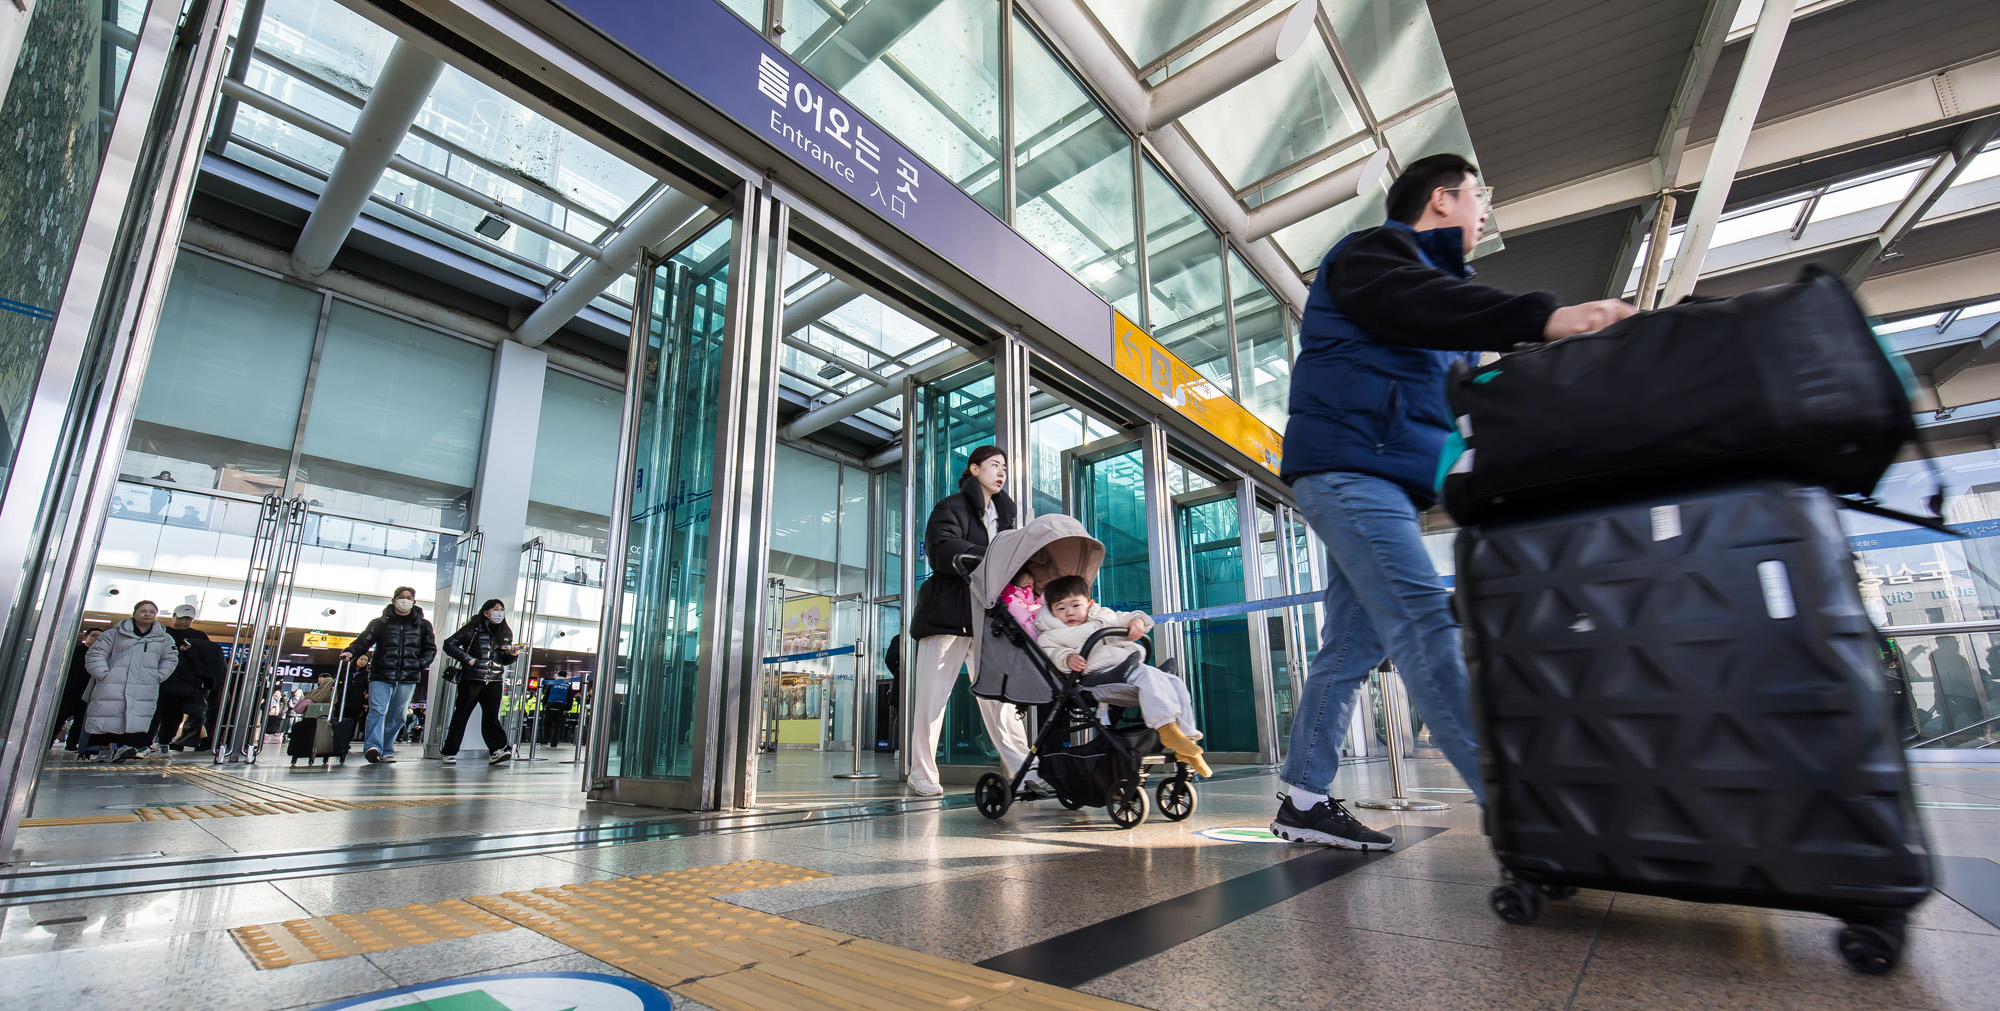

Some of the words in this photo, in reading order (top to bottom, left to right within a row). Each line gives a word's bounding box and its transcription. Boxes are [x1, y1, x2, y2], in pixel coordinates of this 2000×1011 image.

[758, 52, 881, 175] 들어오는
[896, 156, 920, 204] 곳
[770, 109, 855, 184] Entrance
[870, 180, 906, 219] 入口
[1157, 359, 1167, 387] 3
[270, 665, 313, 678] ald's
